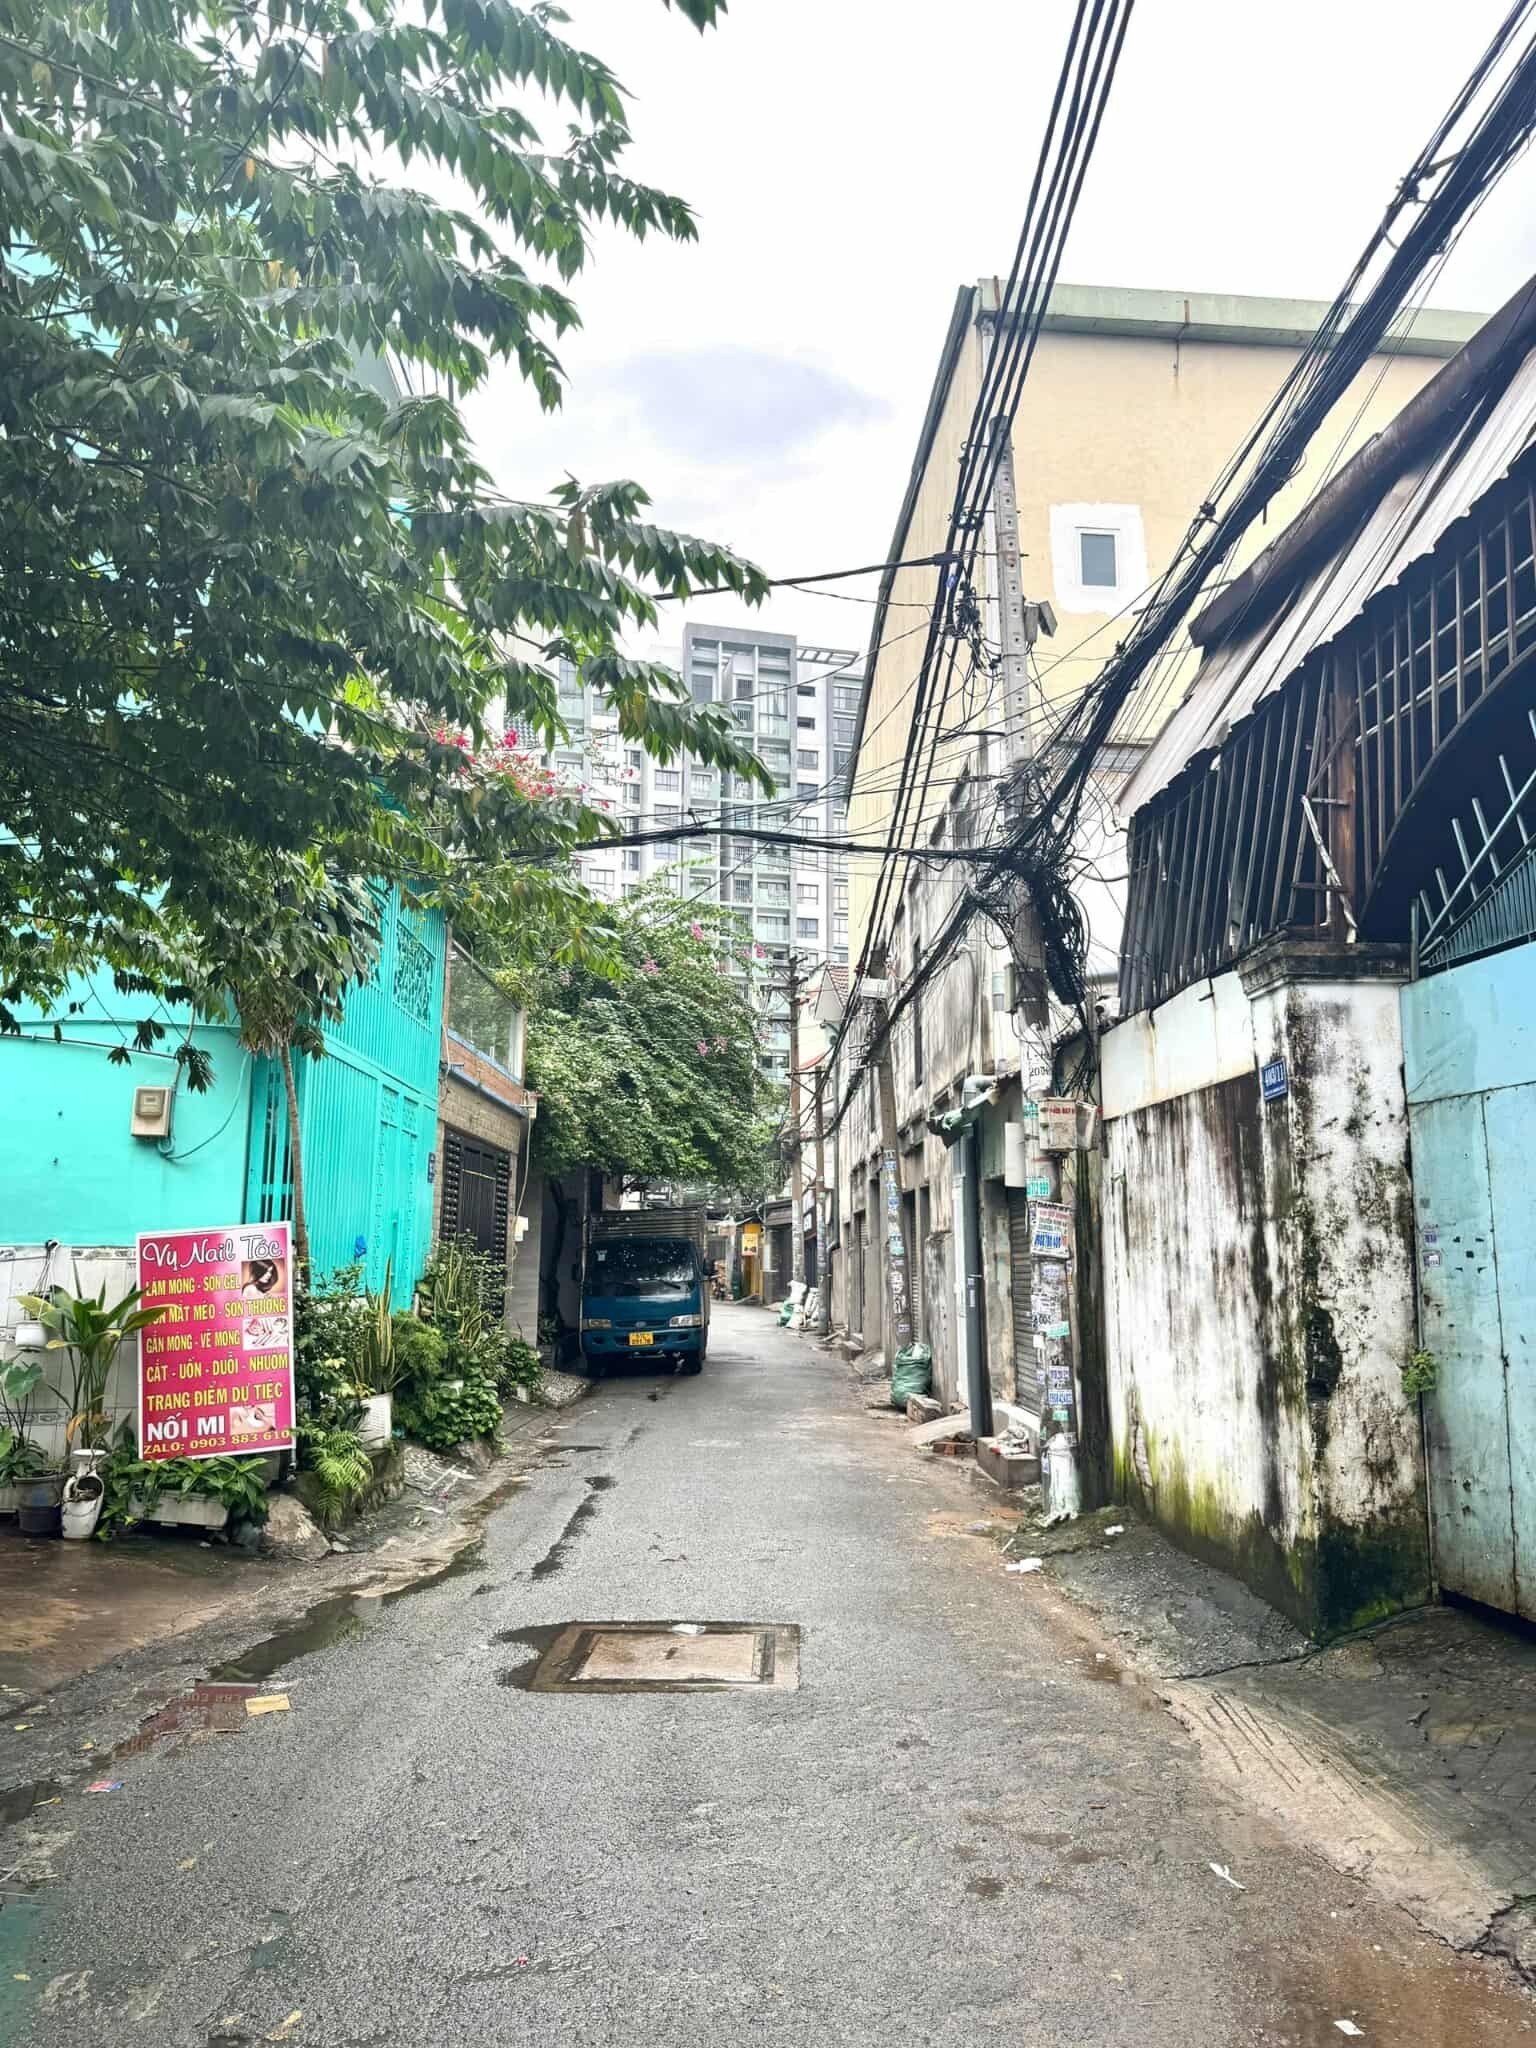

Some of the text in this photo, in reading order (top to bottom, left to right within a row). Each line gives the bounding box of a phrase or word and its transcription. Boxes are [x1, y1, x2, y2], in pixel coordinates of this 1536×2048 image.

[180, 1237, 237, 1269] Nail
[240, 1234, 282, 1260] Tóc
[224, 1273, 241, 1290] GEL
[146, 1358, 168, 1383] CẮT
[146, 1391, 191, 1412] TRANG
[147, 1411, 225, 1442] NỐI MI
[143, 1428, 290, 1455] ZALO: 0903 883 610
